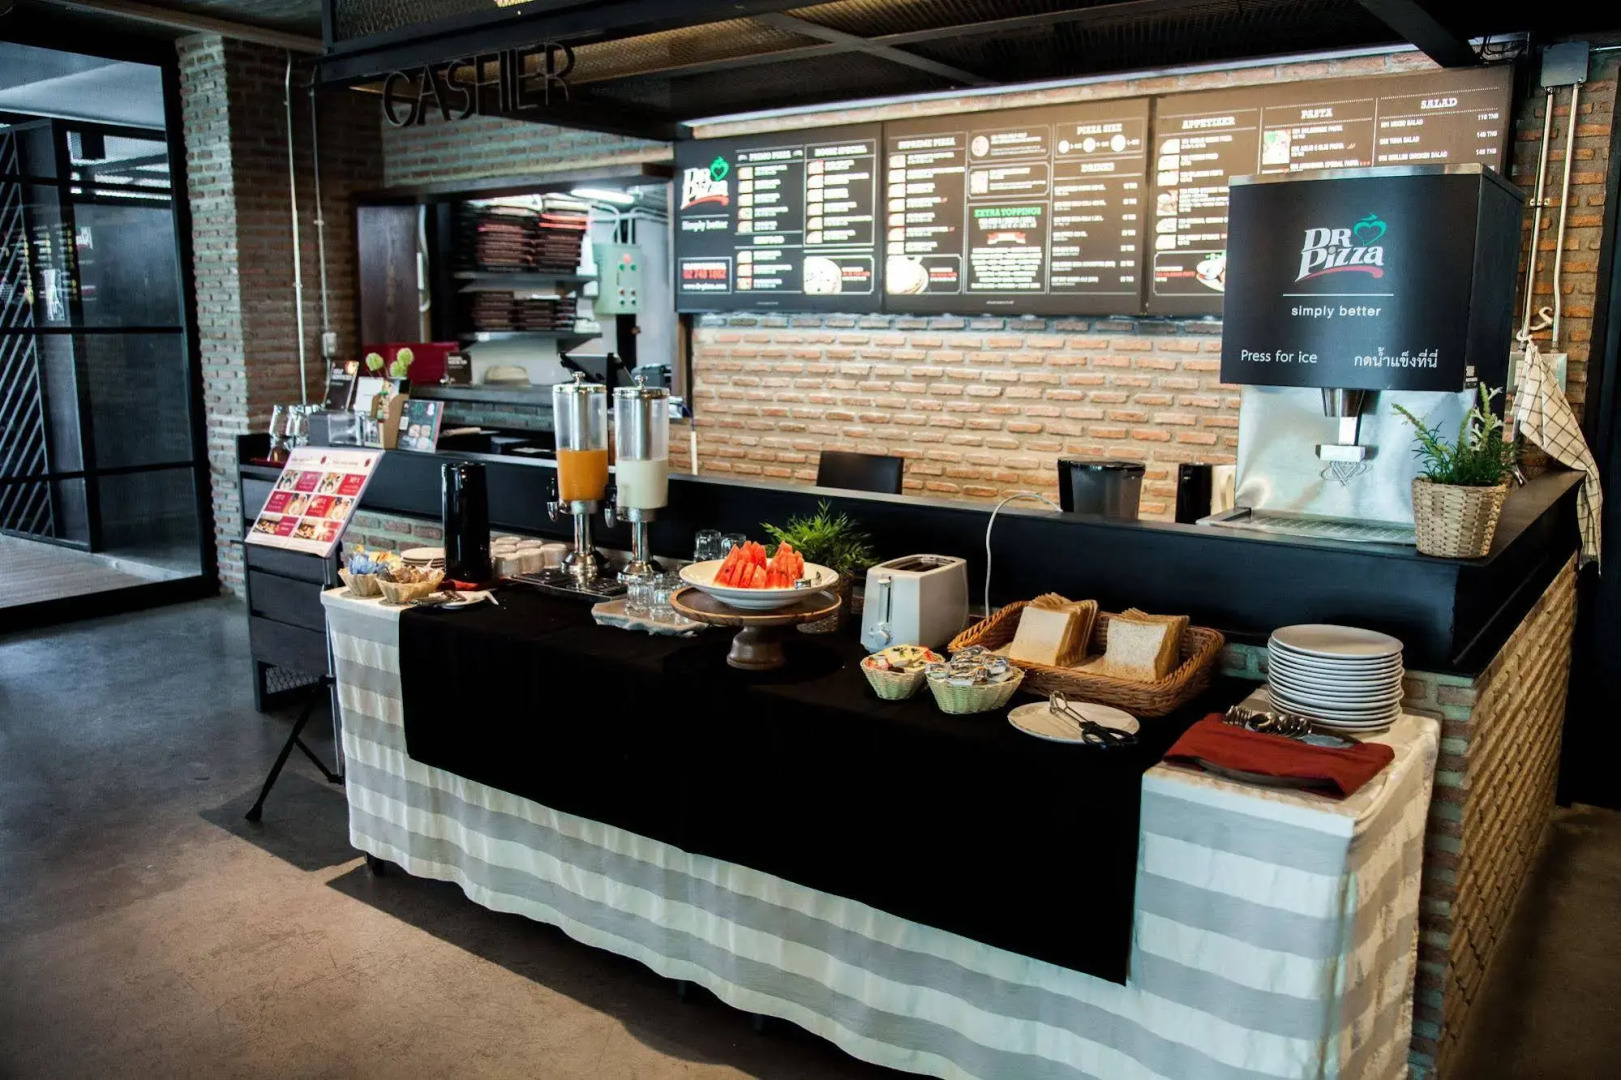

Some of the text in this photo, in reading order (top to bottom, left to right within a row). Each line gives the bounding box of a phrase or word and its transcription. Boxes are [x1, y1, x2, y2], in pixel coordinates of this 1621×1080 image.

[382, 41, 576, 127] CASHIER
[1421, 98, 1458, 109] SALAD
[1301, 108, 1333, 119] PASTA
[974, 209, 1000, 218] EXTRA
[1302, 227, 1352, 252] DR
[1294, 244, 1385, 283] Pizza
[1291, 304, 1382, 319] simply better
[1241, 349, 1318, 364] Press for ice
[1353, 346, 1439, 369] กดน้ำแข็งที่นี่
